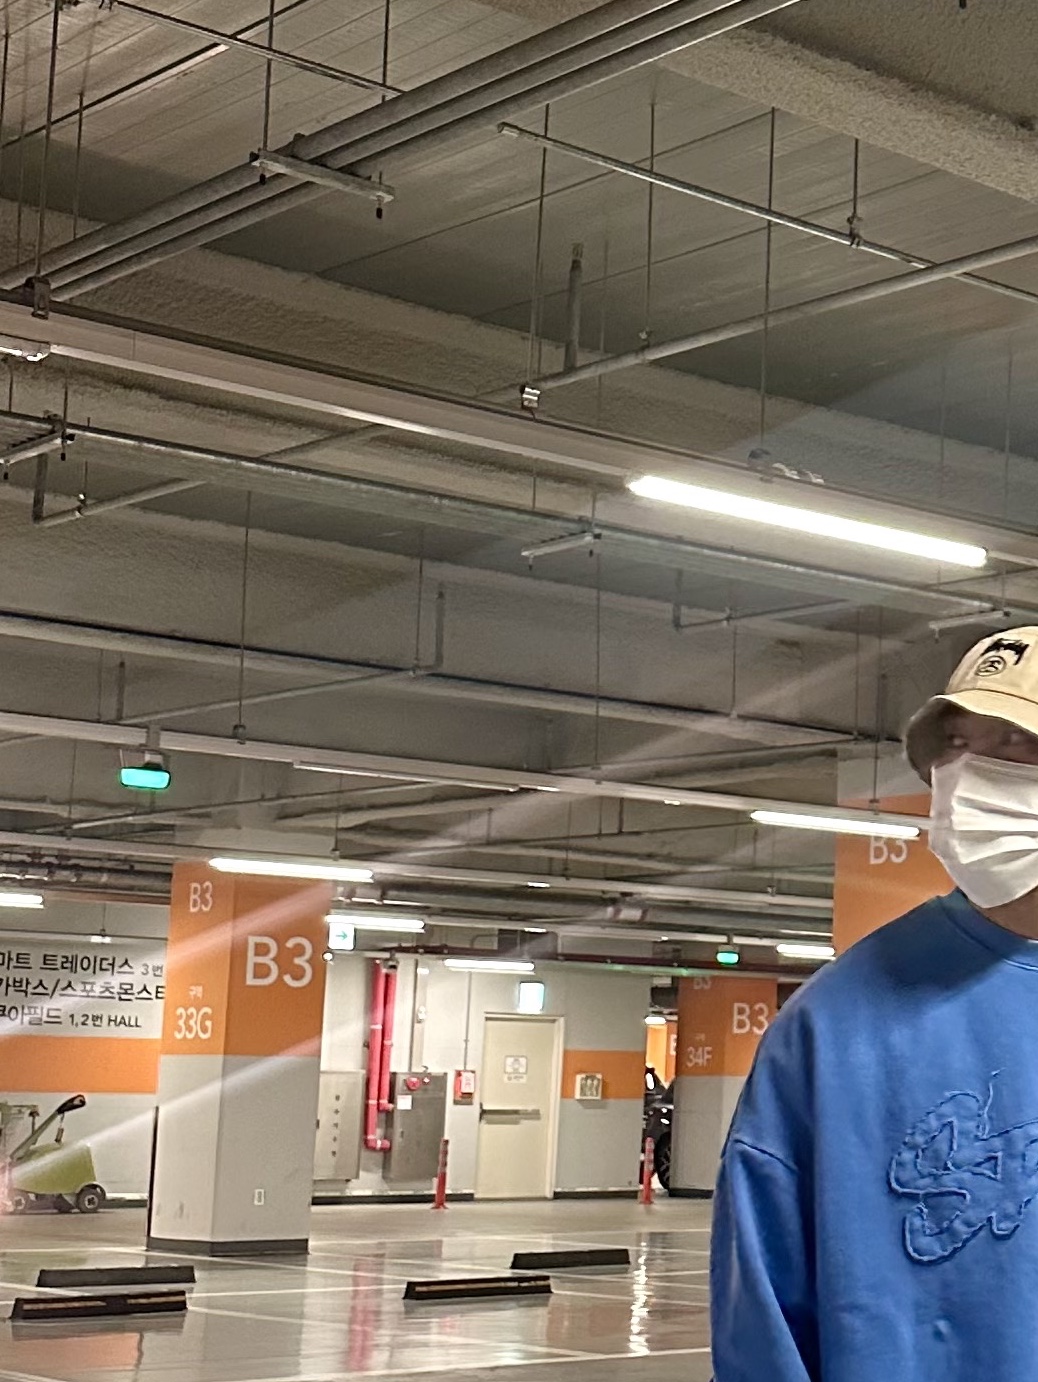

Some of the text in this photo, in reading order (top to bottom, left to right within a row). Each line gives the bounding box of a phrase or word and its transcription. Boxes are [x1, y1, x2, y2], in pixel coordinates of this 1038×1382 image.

[869, 836, 908, 865] B3
[189, 881, 213, 913] B3
[0, 951, 33, 970] 마트
[40, 953, 135, 976] 트레이더스
[246, 935, 313, 988] B3
[107, 1014, 143, 1029] HALL
[174, 1006, 213, 1040] 33G
[732, 1002, 769, 1036] B3
[686, 1046, 713, 1068] 34F
